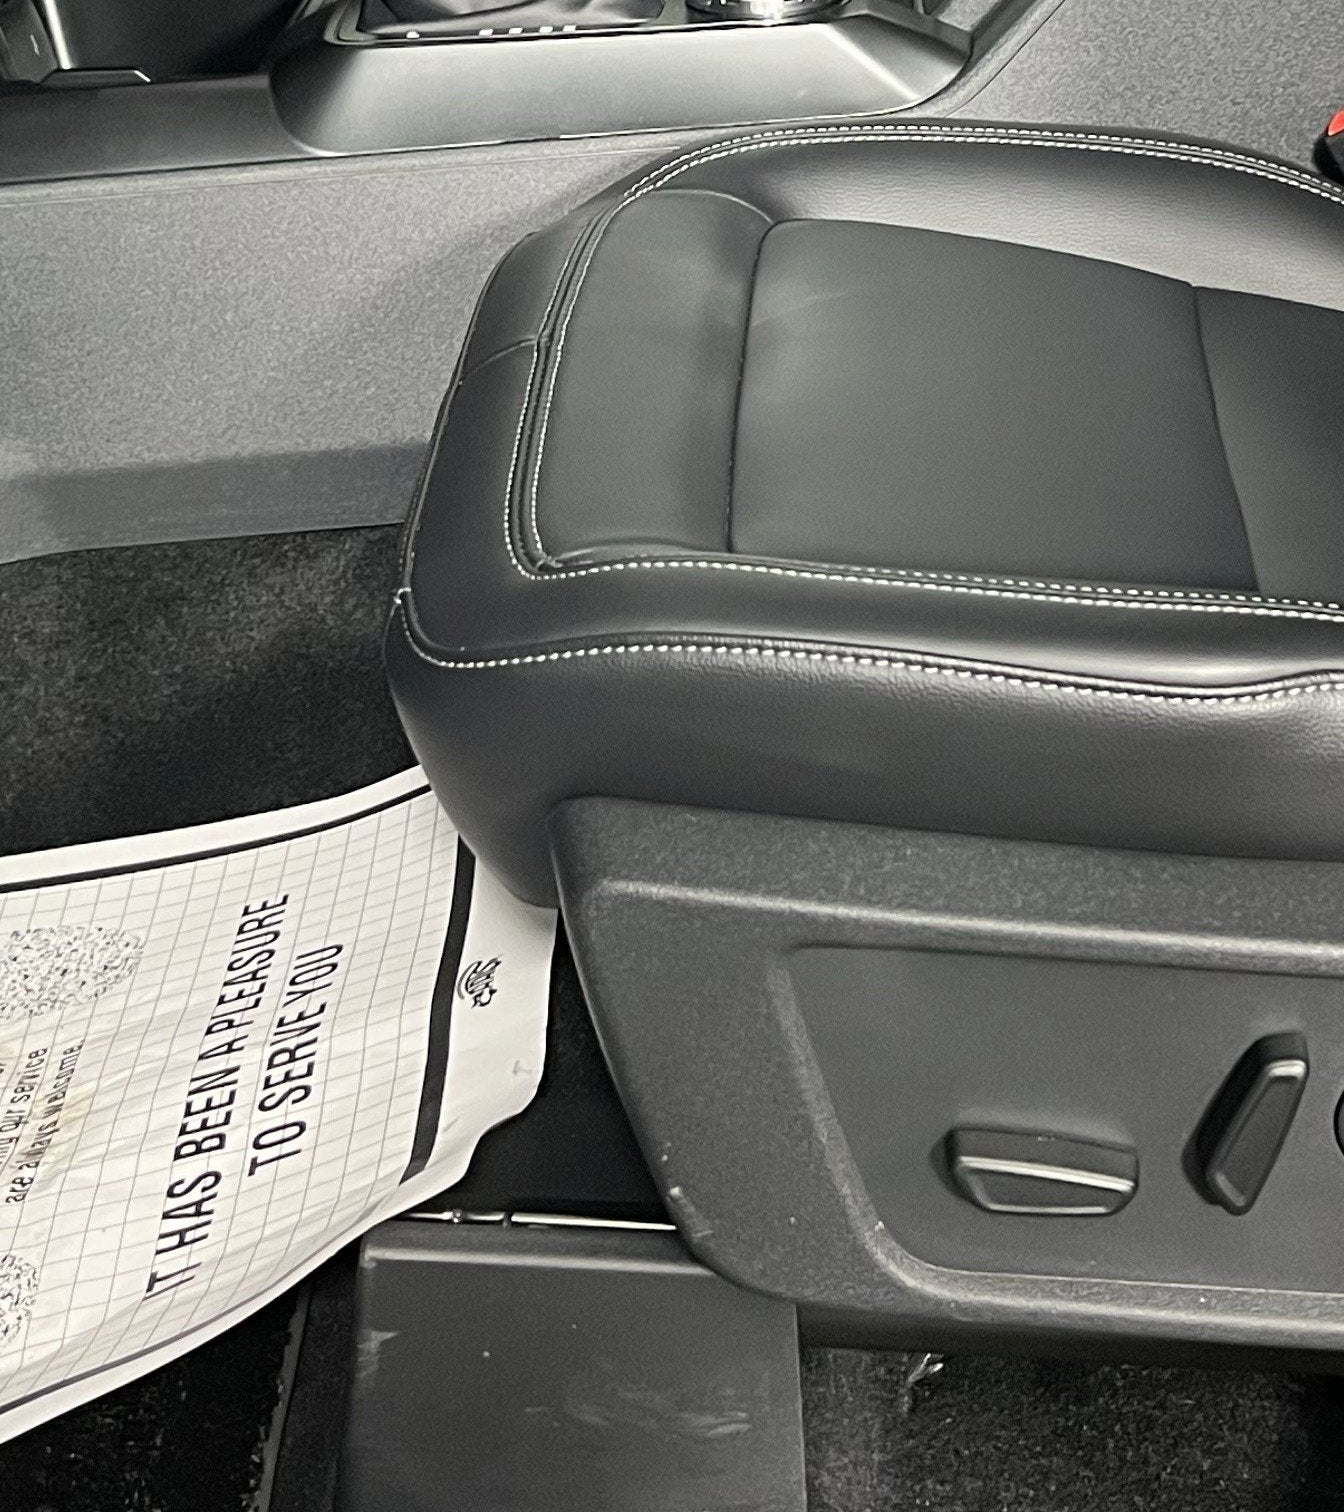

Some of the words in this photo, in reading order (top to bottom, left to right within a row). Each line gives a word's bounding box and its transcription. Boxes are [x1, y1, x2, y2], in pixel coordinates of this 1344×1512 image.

[205, 893, 289, 1038] PLEASURE
[283, 942, 344, 1008] YOU
[10, 1047, 48, 1105] service
[197, 1034, 249, 1062] A
[258, 1001, 327, 1113] SERVE
[0, 1109, 26, 1133] our
[172, 1065, 241, 1163] BEEN
[15, 1121, 60, 1170] always
[247, 1120, 307, 1177] TO
[5, 1176, 34, 1203] are
[155, 1170, 222, 1256] HAS
[143, 1261, 202, 1301] IT
